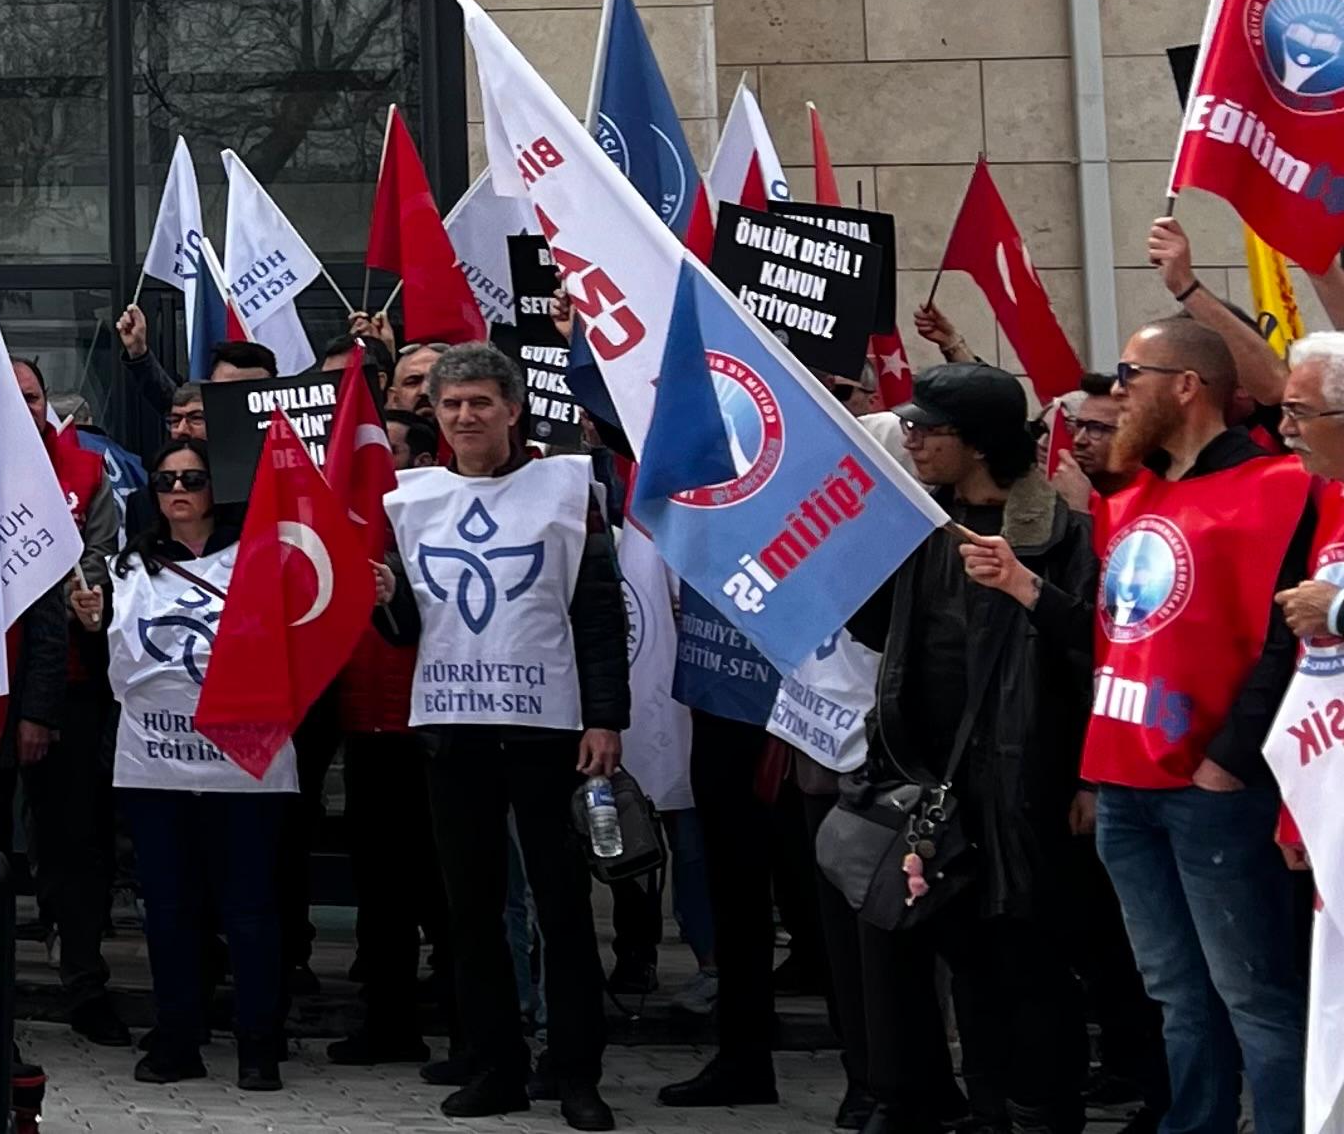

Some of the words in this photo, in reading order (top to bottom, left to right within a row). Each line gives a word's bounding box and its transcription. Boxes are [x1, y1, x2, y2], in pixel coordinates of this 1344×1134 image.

[735, 216, 800, 259] ÖNLÜK
[759, 260, 827, 301] KANUN
[738, 284, 837, 339] İSTİYORUZ
[248, 383, 337, 414] OKULLAR
[422, 659, 547, 689] HÜRRİYETÇİ
[424, 689, 543, 715] EĞİTİM-SEN
